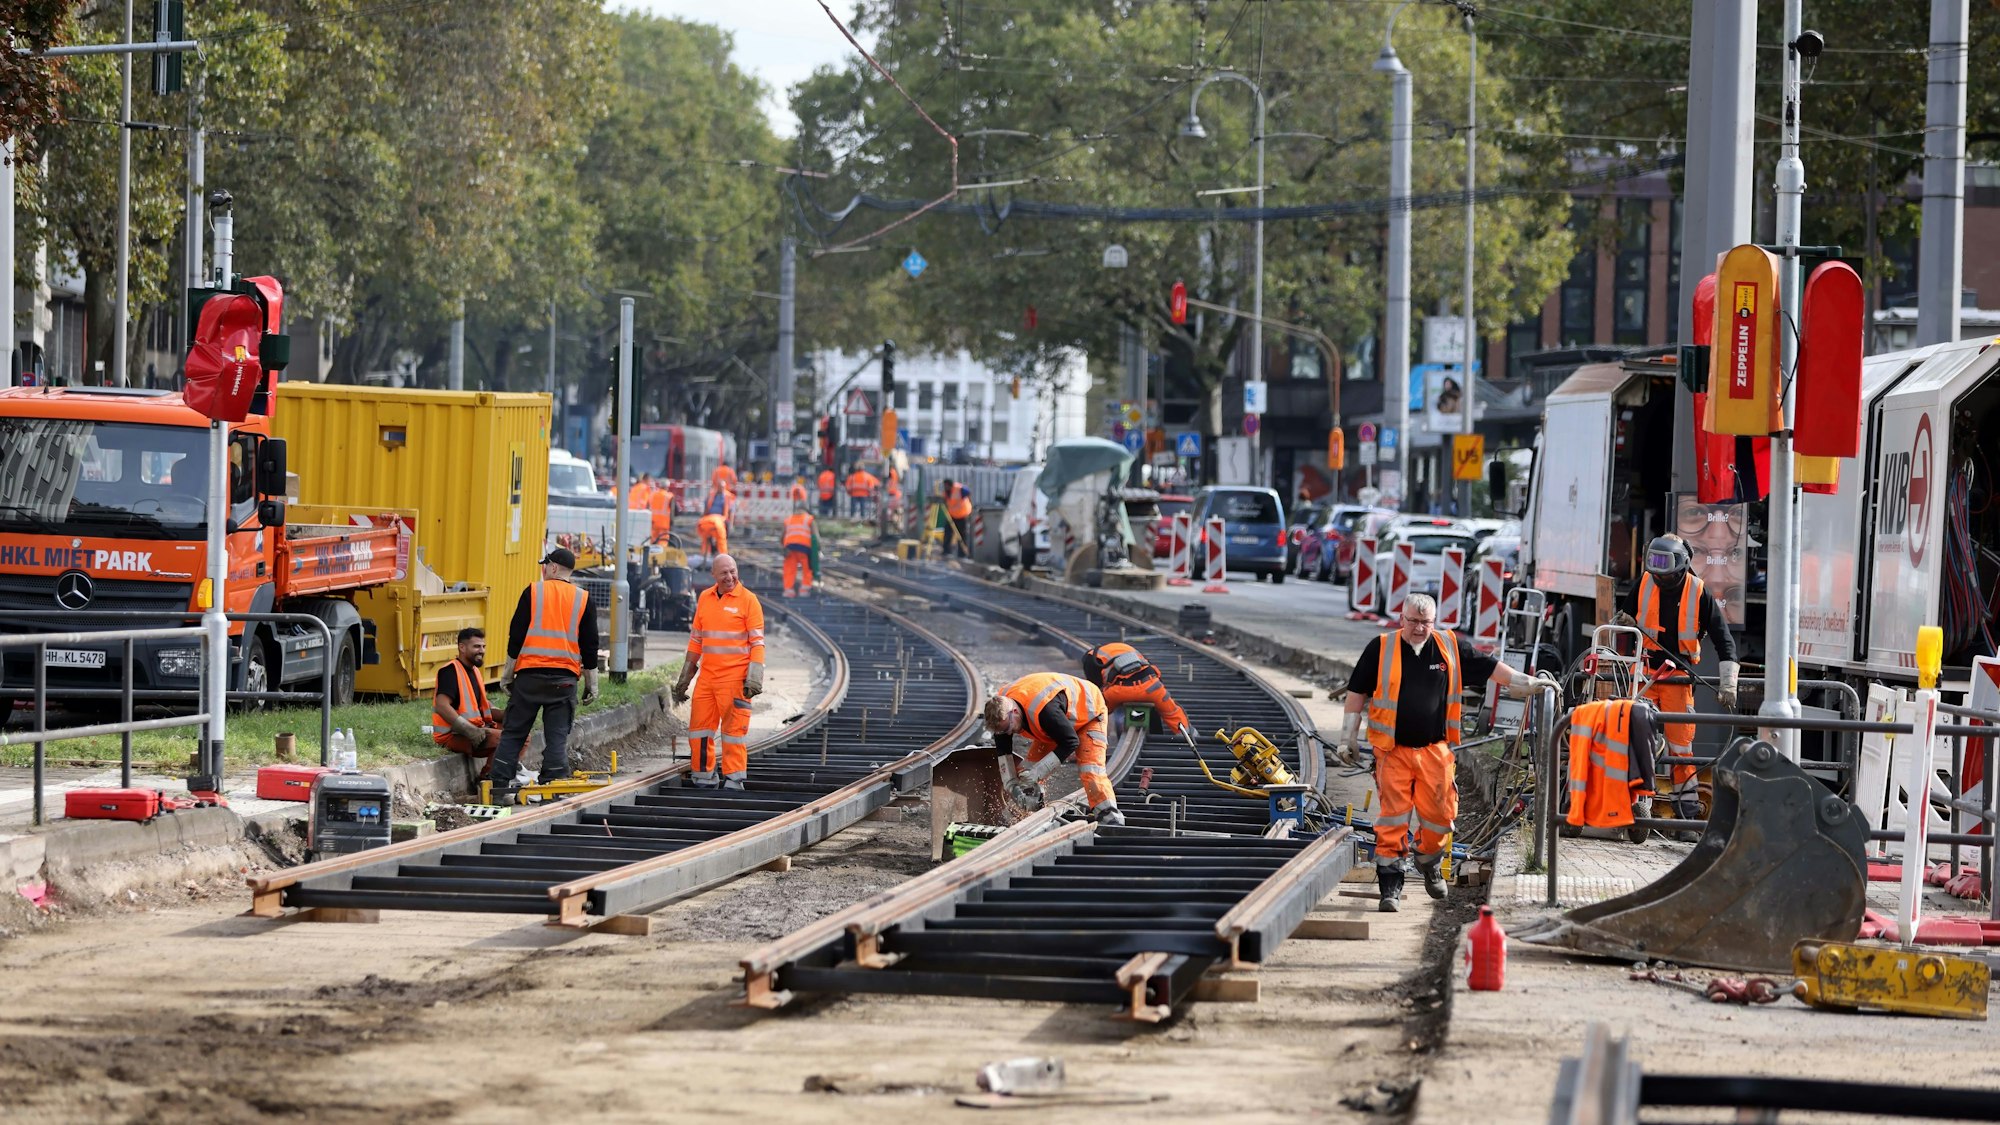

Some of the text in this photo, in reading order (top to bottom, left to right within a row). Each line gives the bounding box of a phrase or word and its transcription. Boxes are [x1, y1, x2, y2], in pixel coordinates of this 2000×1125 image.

[1737, 325, 1749, 387] ZEPPELIN
[1879, 451, 1910, 535] KVB
[1707, 513, 1729, 523] Brille?
[0, 545, 153, 572] HKL MIETPARK
[1706, 556, 1728, 565] Brille?
[45, 651, 104, 664] HH KL 5478
